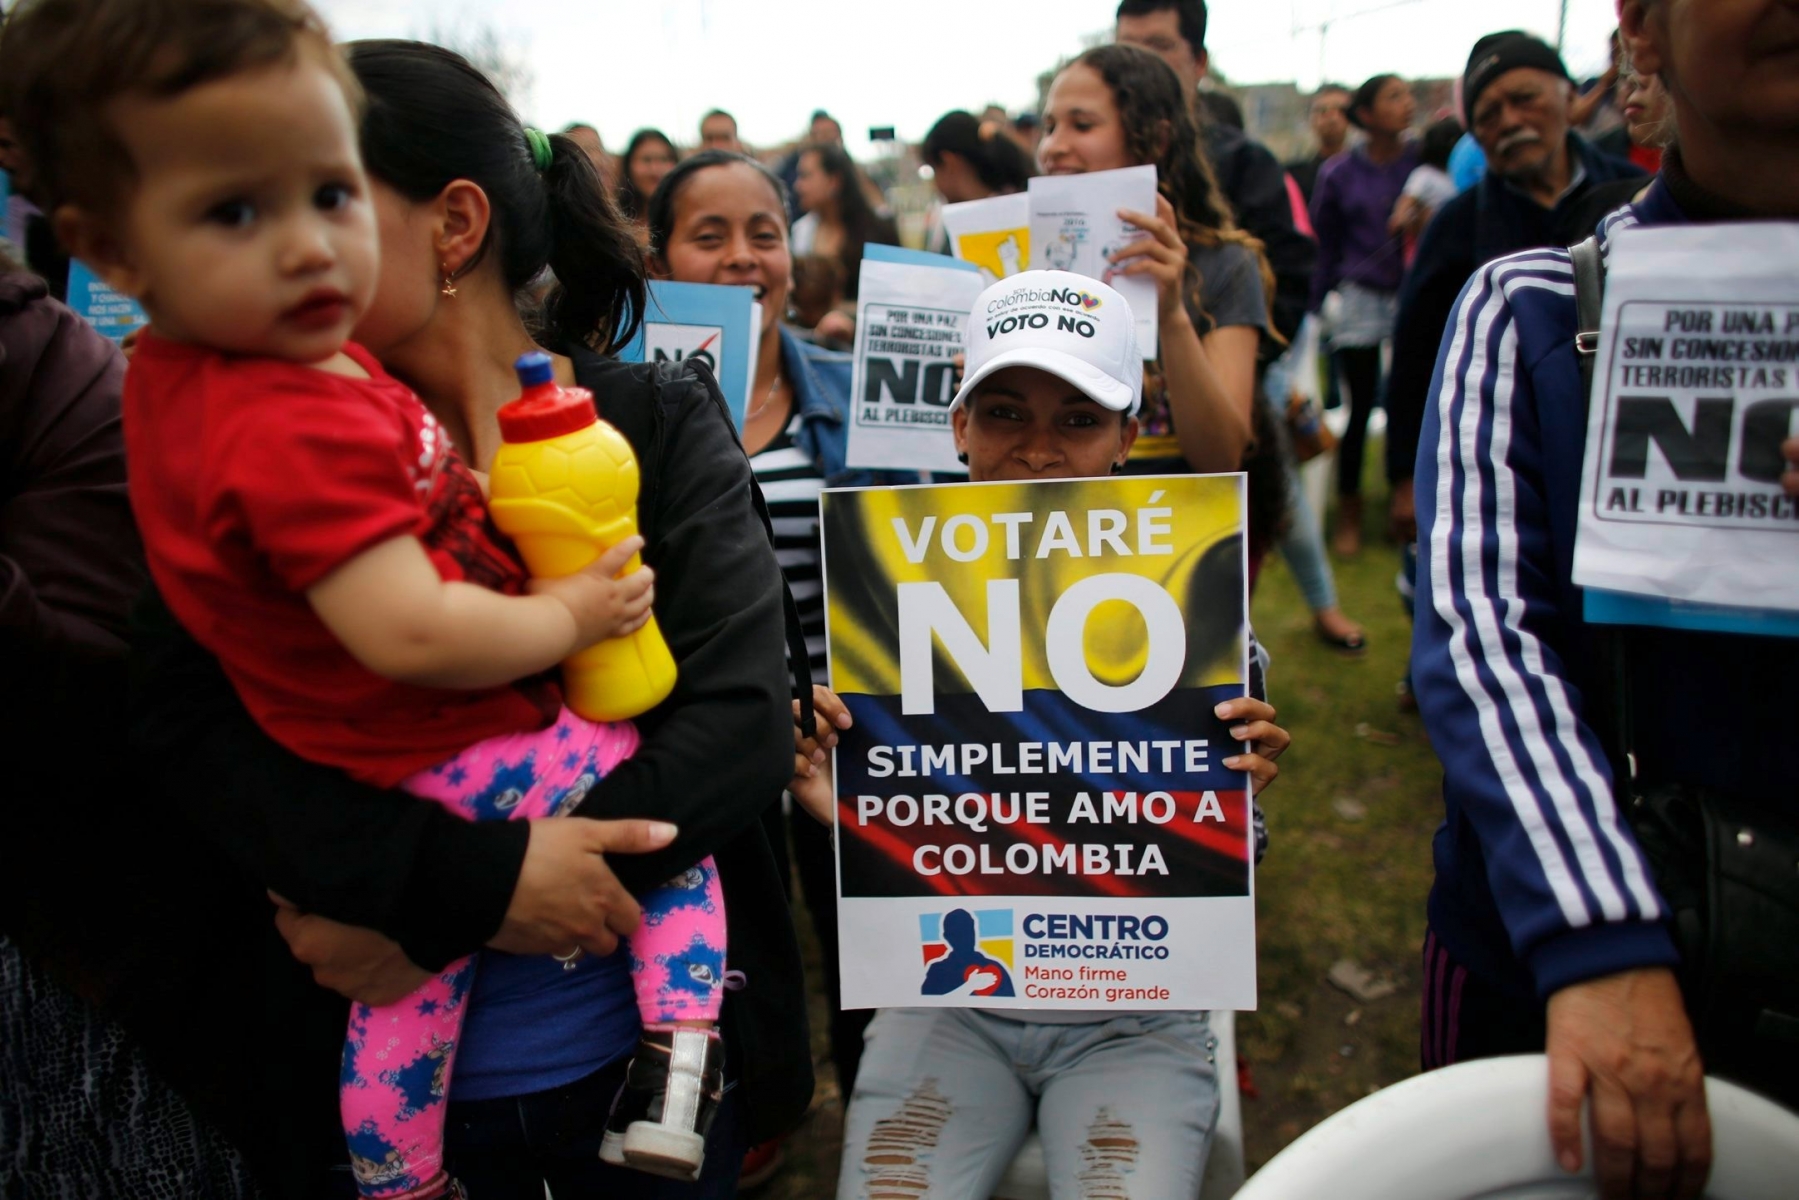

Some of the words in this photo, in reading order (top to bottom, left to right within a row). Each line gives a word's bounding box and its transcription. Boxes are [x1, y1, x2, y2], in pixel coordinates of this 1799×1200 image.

[886, 310, 909, 324] POR
[912, 312, 933, 325] UNA
[937, 315, 958, 328] PAZ
[986, 312, 1049, 340] VOTO
[1056, 314, 1096, 339] NO
[1075, 310, 1101, 322] acuerdo
[1664, 309, 1713, 333] POR
[1721, 310, 1775, 334] UNA
[868, 324, 888, 336] SIN
[890, 325, 962, 343] CONCESIONES
[868, 338, 943, 357] TERRORISTAS
[1622, 337, 1664, 360] SIN
[1621, 364, 1787, 389] TERRORISTAS
[862, 407, 880, 421] AL
[1605, 487, 1645, 513] AL
[891, 490, 1174, 564] VOTARÉ
[896, 571, 1187, 716] NO
[866, 739, 1210, 778] SIMPLEMENTE
[857, 791, 1051, 832] PORQUE
[1066, 791, 1177, 825] AMO
[1192, 790, 1226, 823] A
[912, 843, 1170, 876] COLOMBIA
[1022, 913, 1169, 941] CENTRO
[1024, 942, 1170, 960] DEMOCRÁTICO
[1024, 965, 1074, 981] Mano
[1079, 966, 1127, 981] firme
[1024, 984, 1100, 999] Corazón
[1105, 986, 1170, 1002] grande
